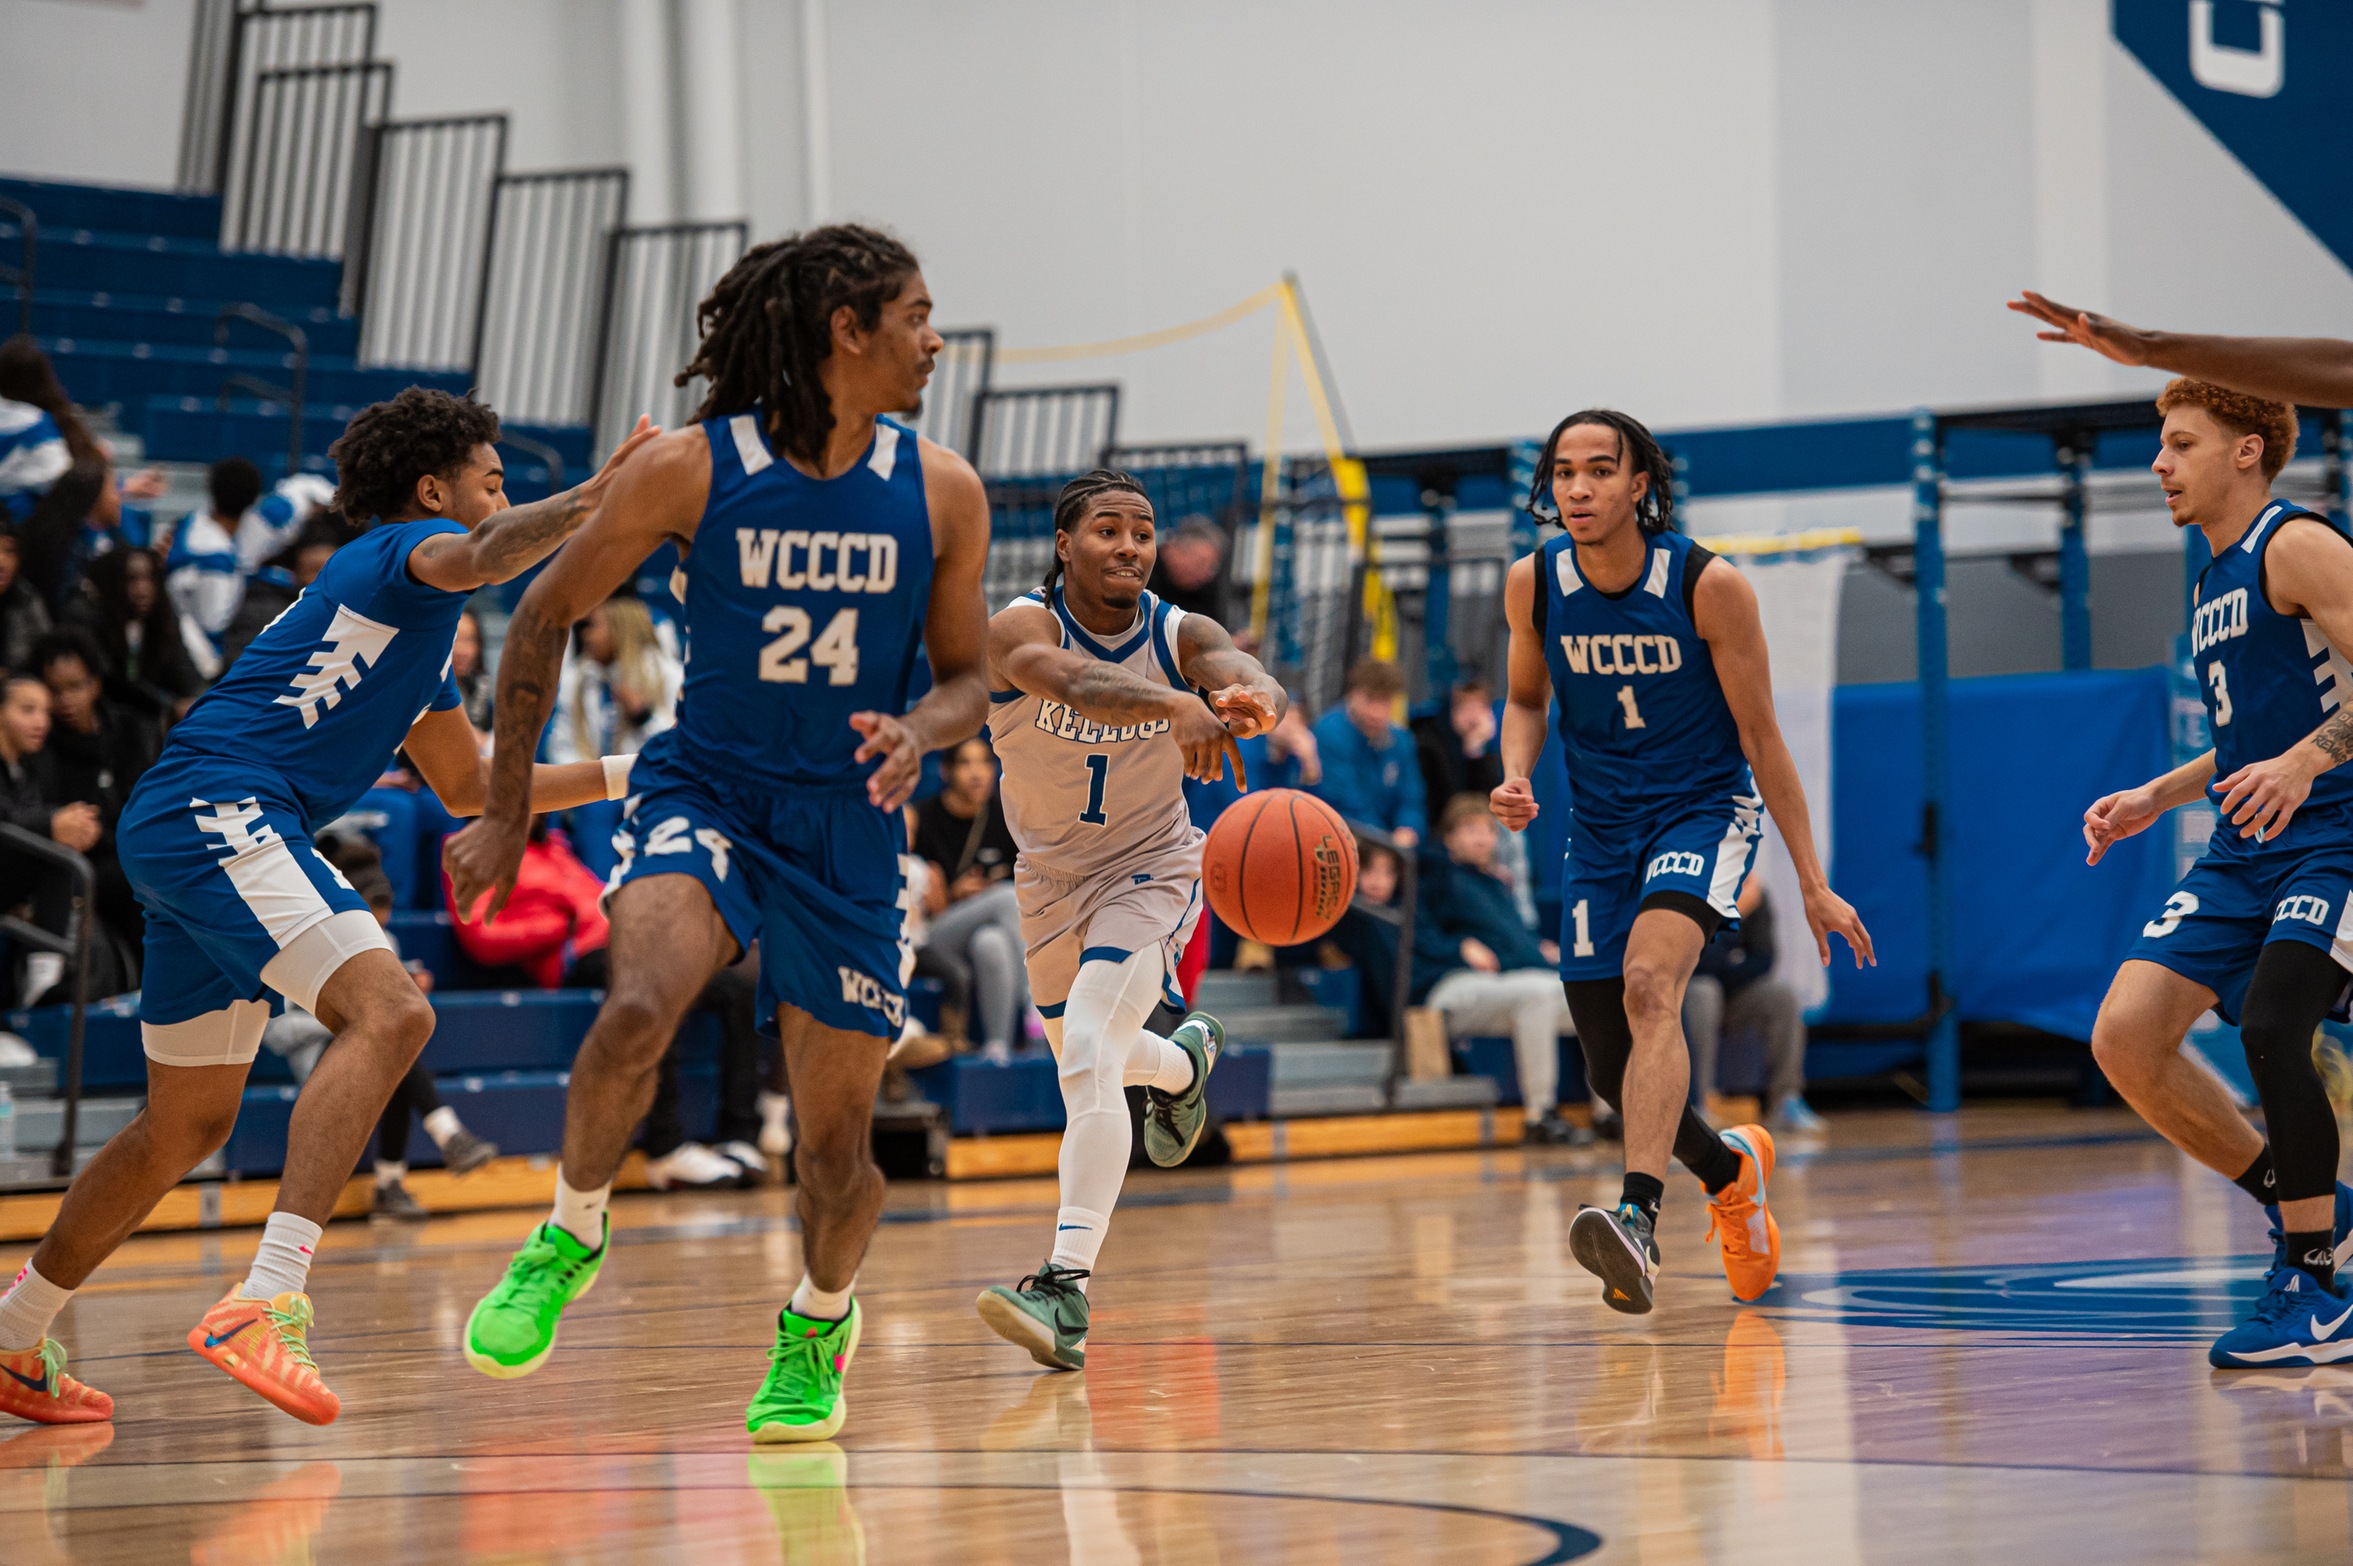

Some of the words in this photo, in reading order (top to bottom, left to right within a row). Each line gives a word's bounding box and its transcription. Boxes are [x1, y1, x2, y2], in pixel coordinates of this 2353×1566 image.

[735, 527, 898, 594] WCCCD
[758, 604, 859, 687] 24
[1560, 634, 1682, 675] WCCCD
[1034, 698, 1171, 744] KELLG
[1616, 685, 1646, 729] 1
[2208, 659, 2233, 728] 3
[1078, 753, 1110, 828] 1
[1572, 899, 1595, 957] 1
[2142, 890, 2200, 938] 3
